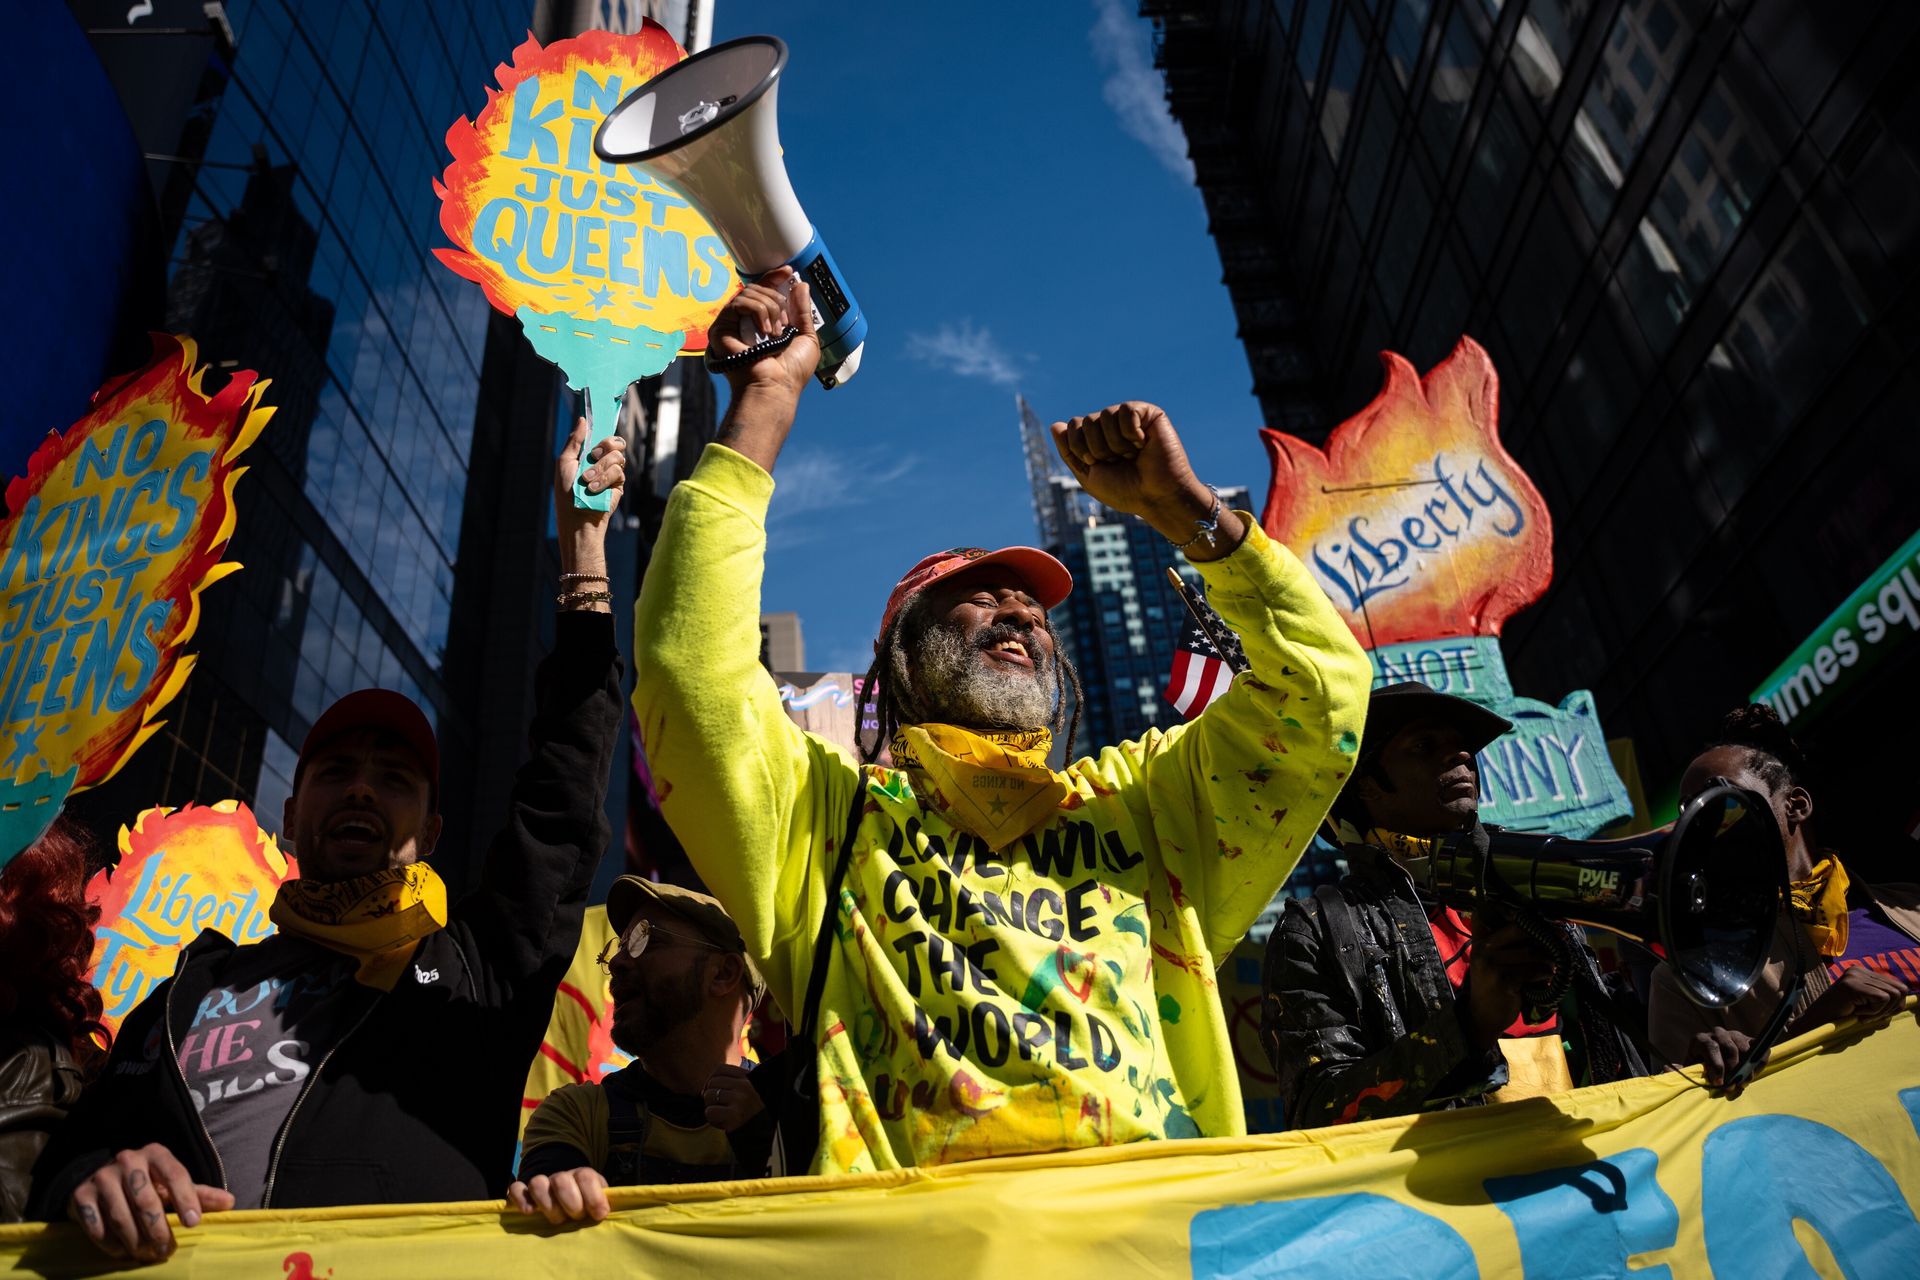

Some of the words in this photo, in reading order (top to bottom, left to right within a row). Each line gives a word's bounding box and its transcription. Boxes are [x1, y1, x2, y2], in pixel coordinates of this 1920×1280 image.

[515, 167, 690, 226] JUST
[473, 197, 730, 302] QUEENS
[72, 418, 168, 488] NO
[1, 449, 215, 589] KINGS
[1311, 452, 1528, 612] Liberty
[1, 558, 151, 642] JUST
[1381, 647, 1477, 694] NOT
[1757, 626, 1859, 726] imes
[888, 816, 1004, 878] LOVE
[883, 870, 1101, 943] CHANGE
[892, 930, 1000, 998] THE
